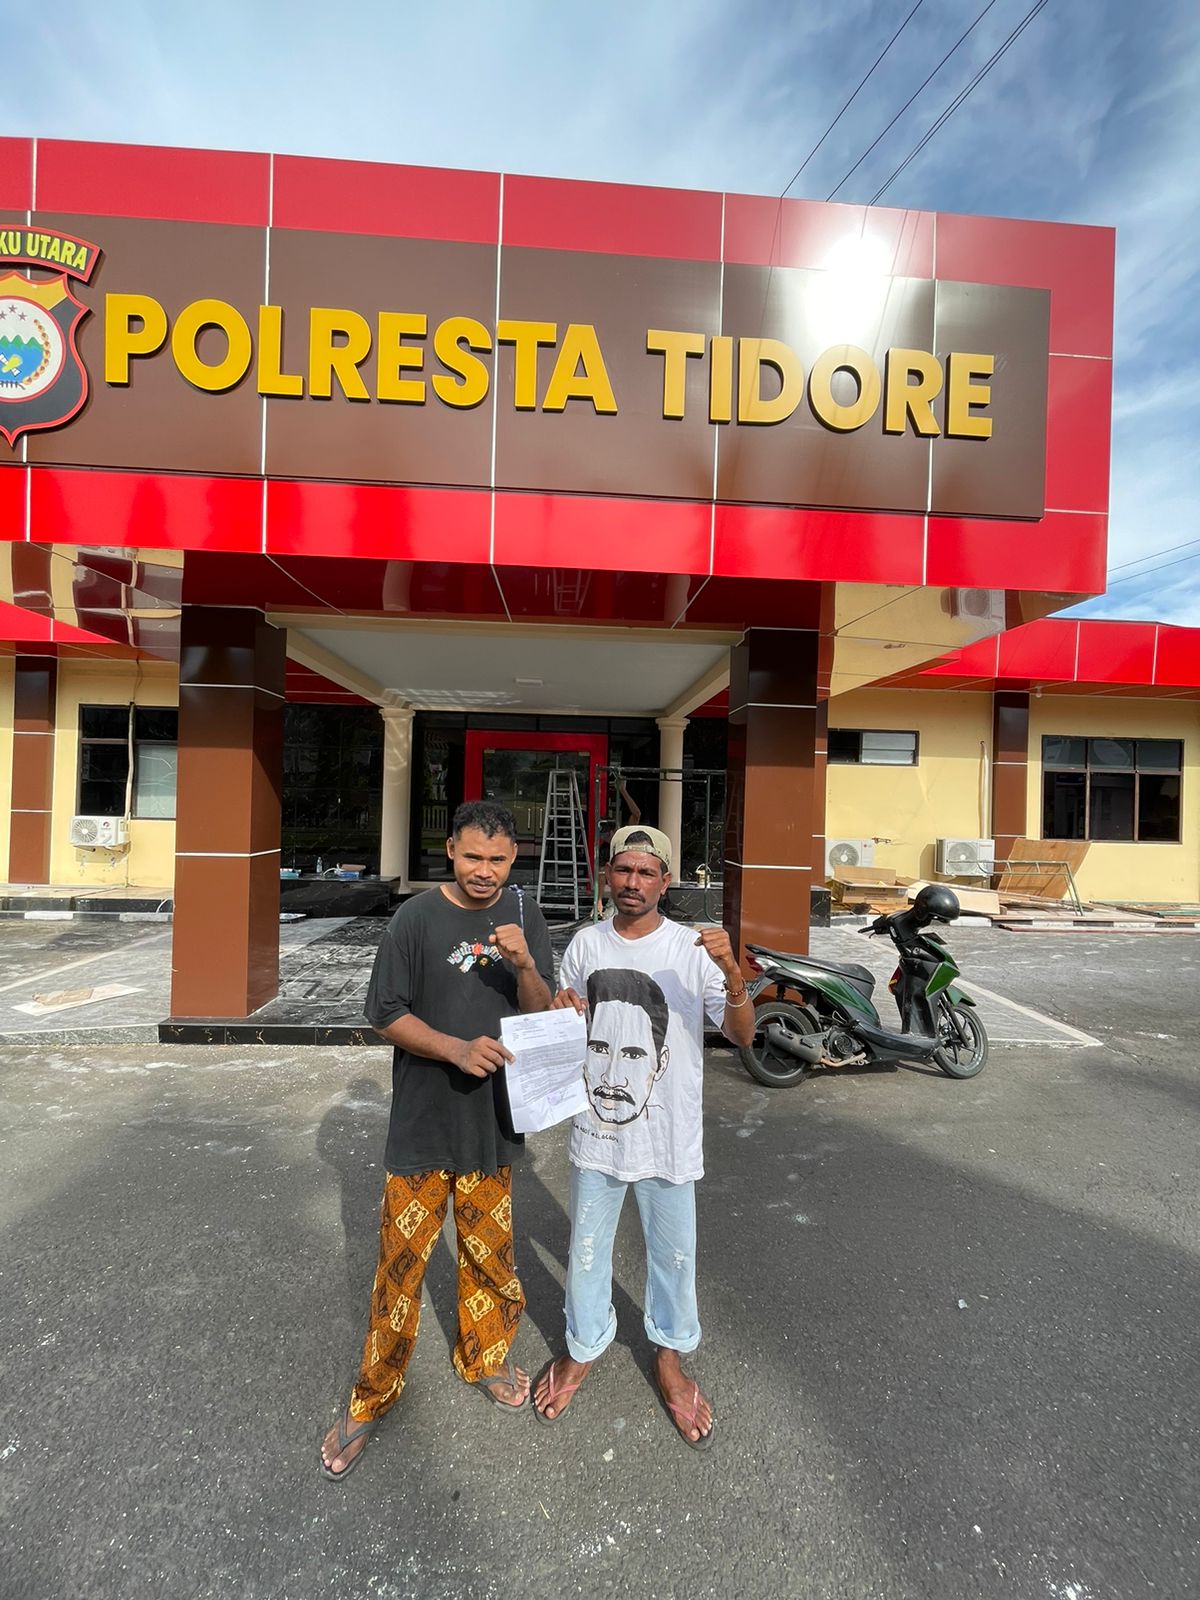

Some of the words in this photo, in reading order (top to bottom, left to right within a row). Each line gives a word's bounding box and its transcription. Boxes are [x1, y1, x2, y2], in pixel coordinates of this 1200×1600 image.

[26, 232, 88, 271] UTARA
[104, 292, 618, 416] POLRESTA
[646, 328, 995, 440] TIDORE
